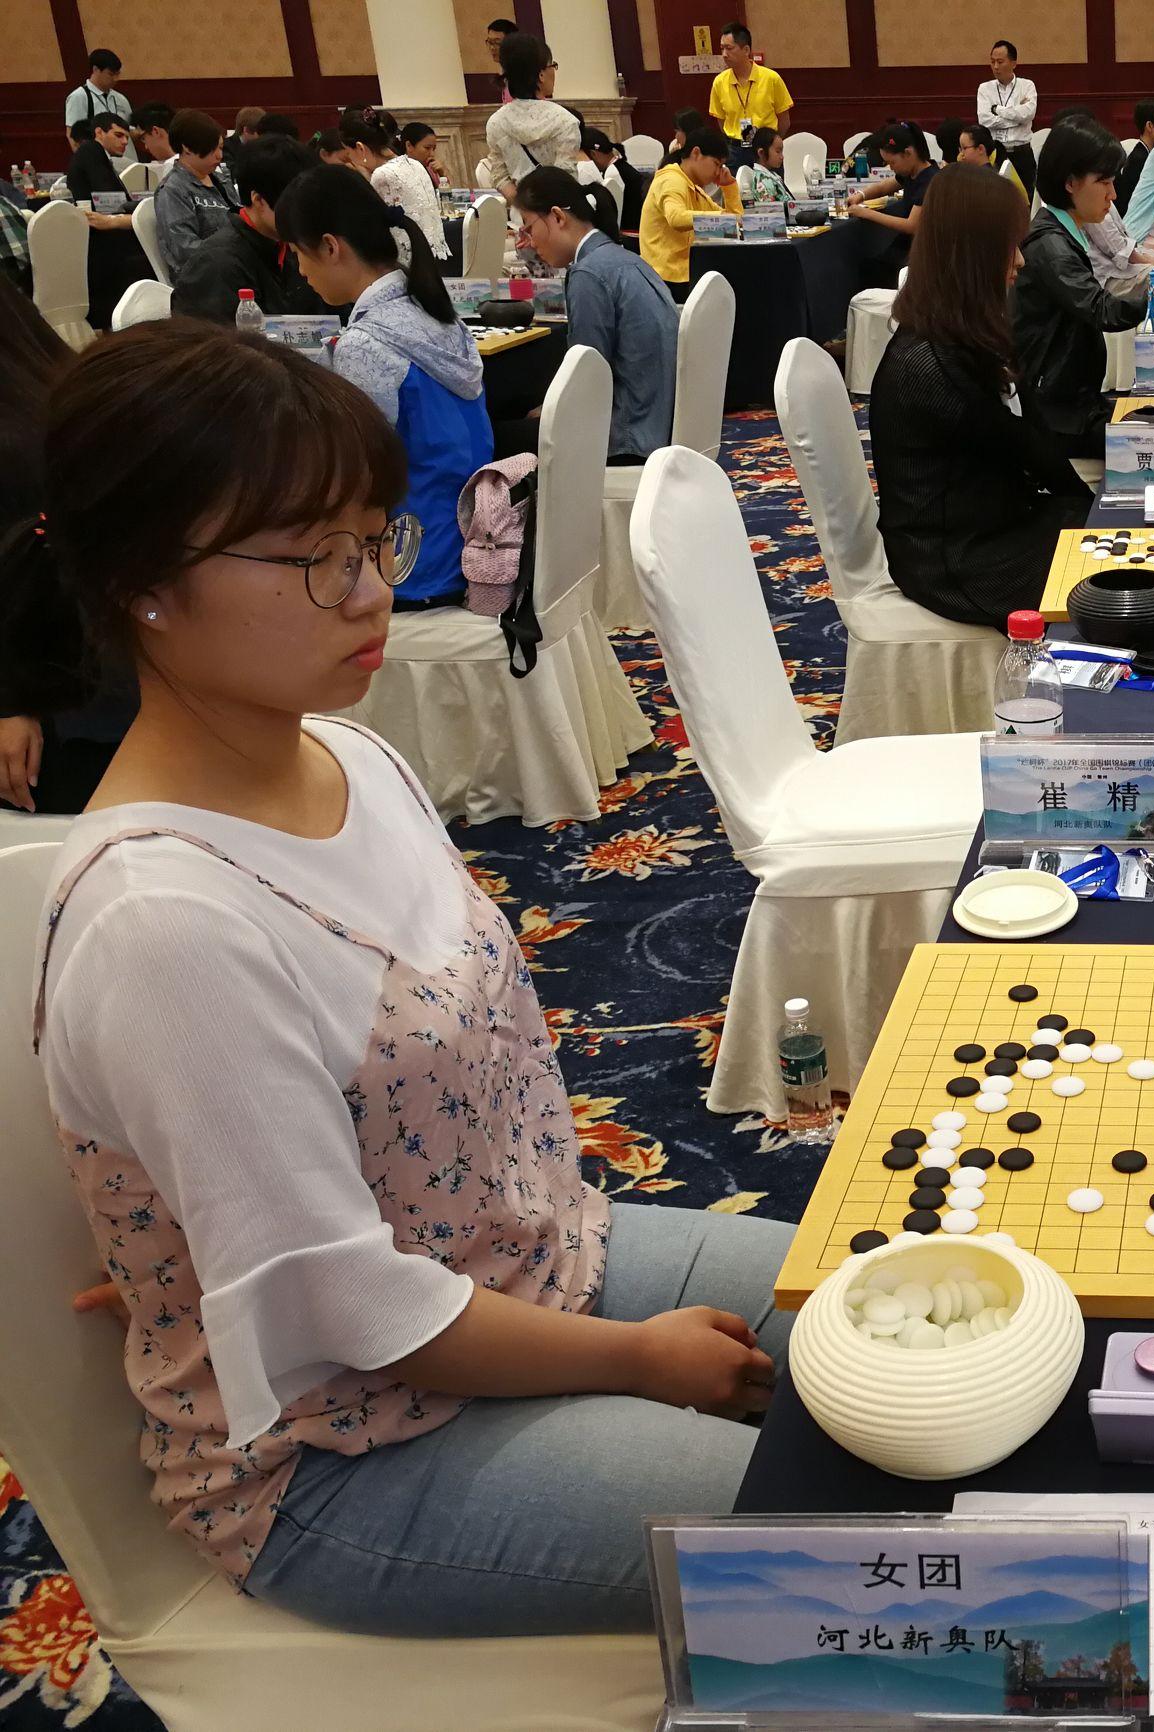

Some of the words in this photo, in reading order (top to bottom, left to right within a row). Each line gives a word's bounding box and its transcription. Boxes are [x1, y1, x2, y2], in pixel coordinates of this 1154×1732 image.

[860, 1552, 963, 1591] 女团
[816, 1624, 1022, 1655] 河北新奥队
